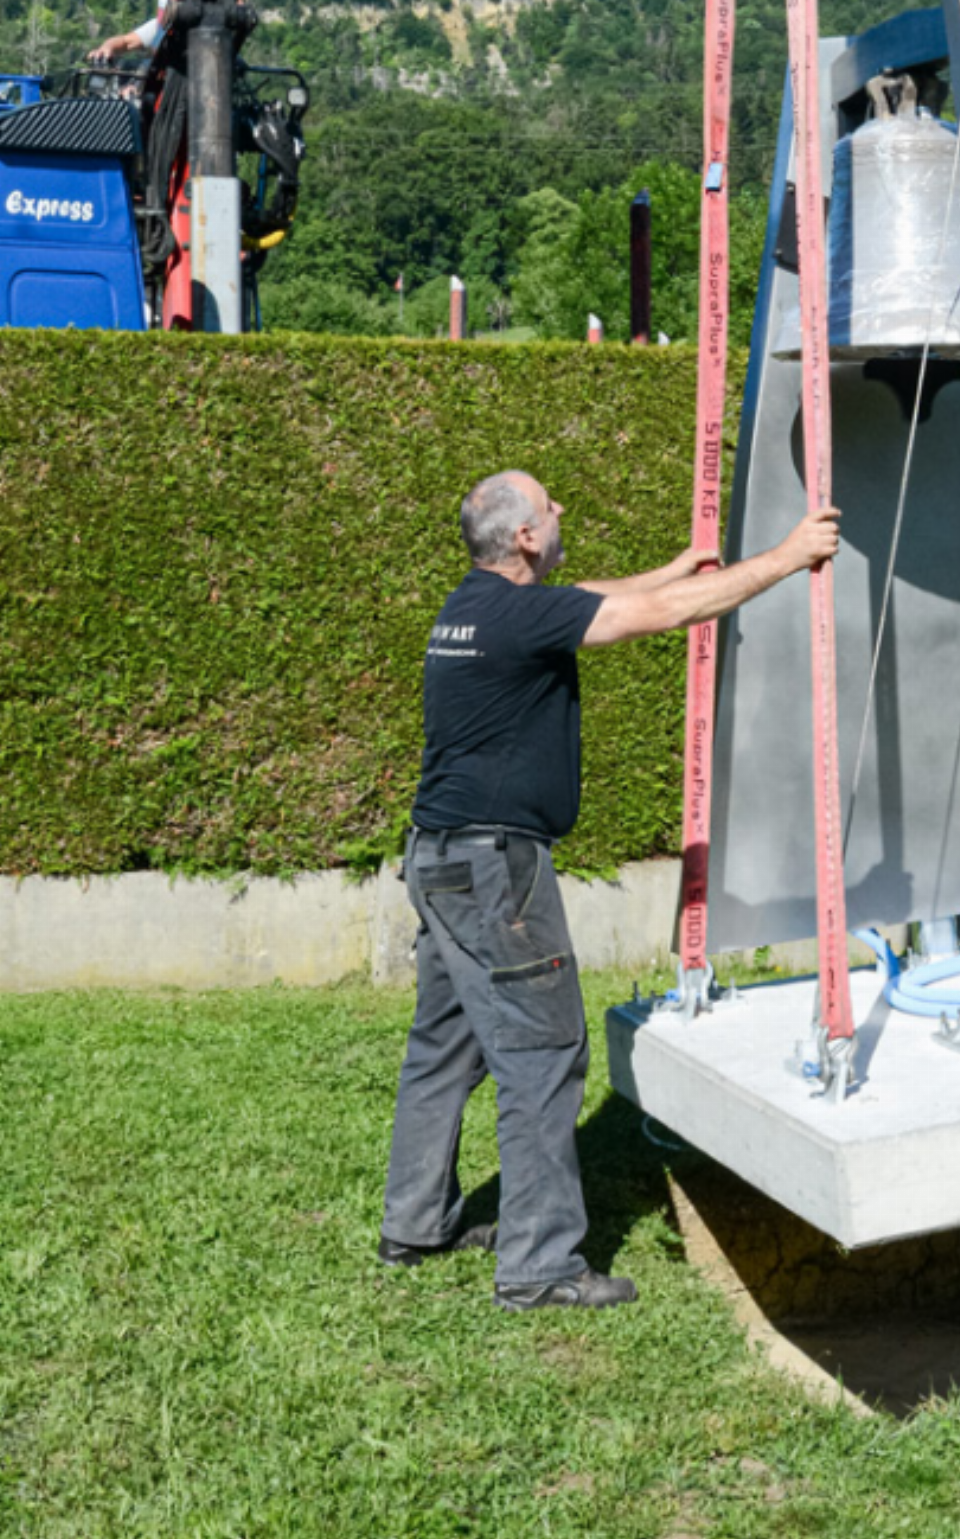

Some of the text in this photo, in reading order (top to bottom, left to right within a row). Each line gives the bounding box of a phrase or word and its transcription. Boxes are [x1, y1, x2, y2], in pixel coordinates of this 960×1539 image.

[6, 190, 93, 222] Express
[701, 490, 718, 520] KG
[696, 625, 711, 665] Set
